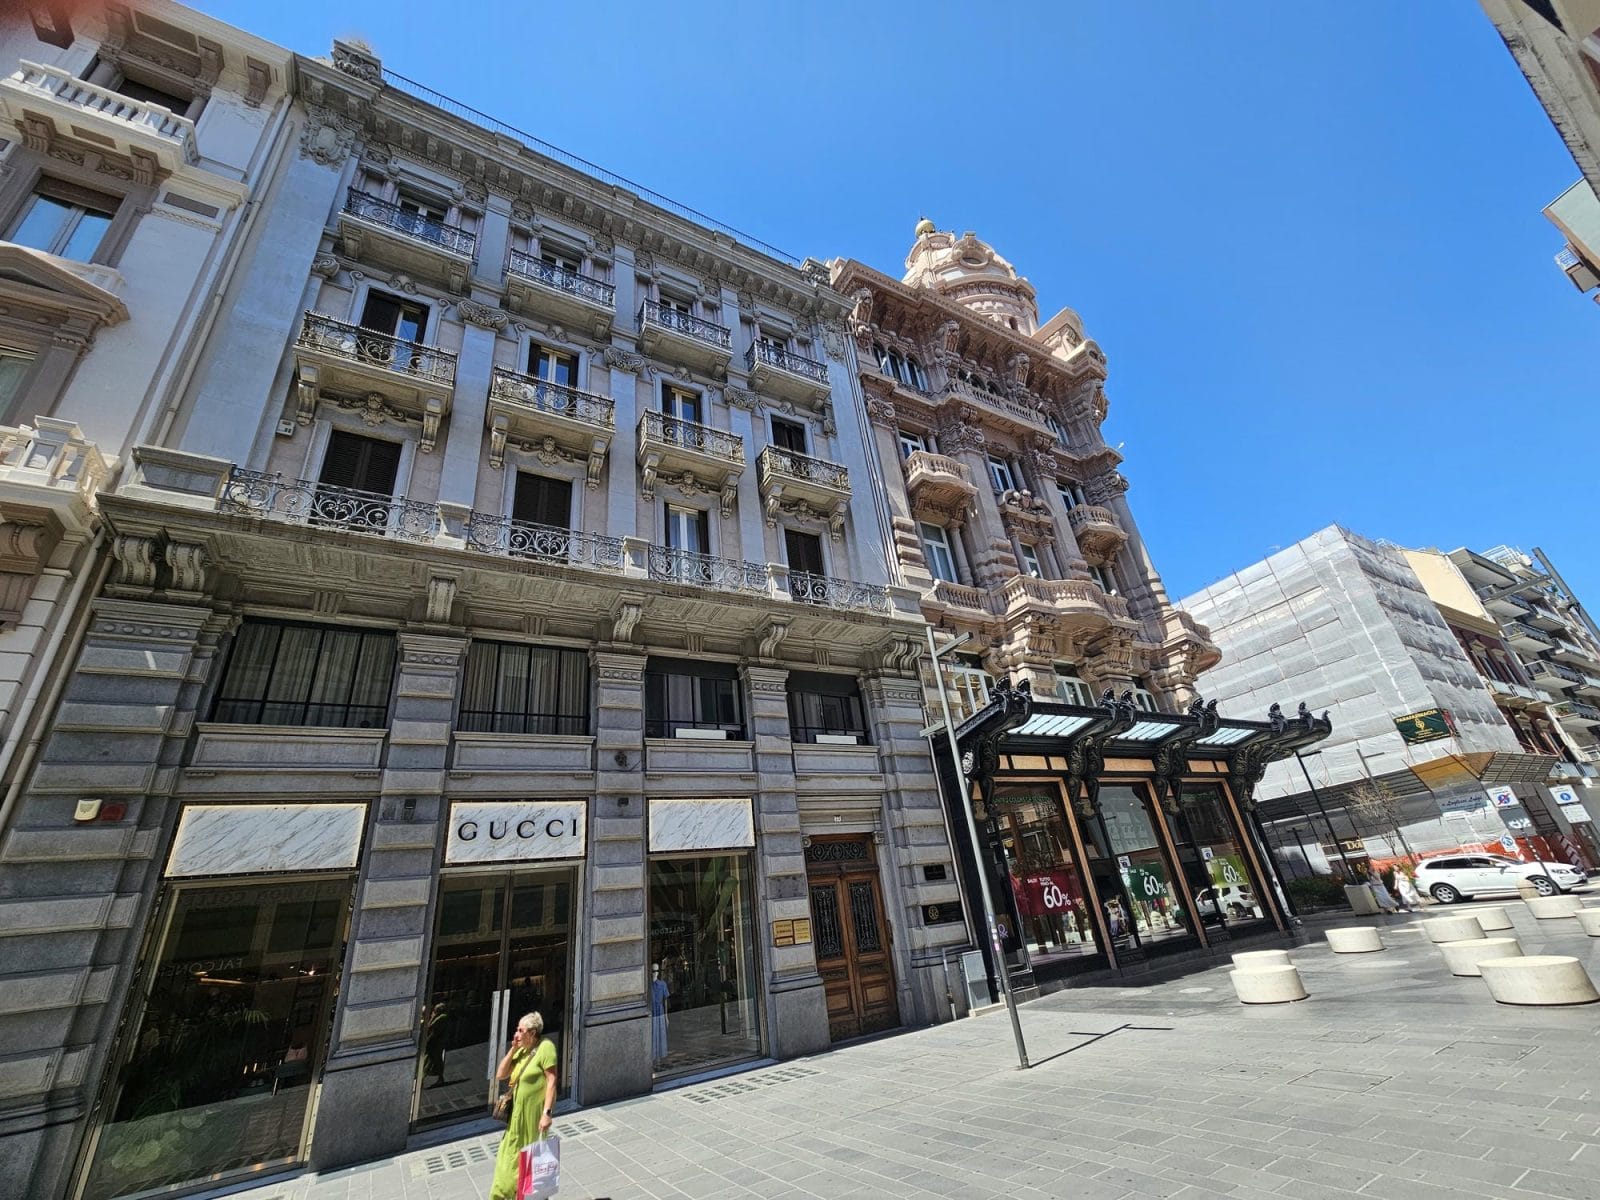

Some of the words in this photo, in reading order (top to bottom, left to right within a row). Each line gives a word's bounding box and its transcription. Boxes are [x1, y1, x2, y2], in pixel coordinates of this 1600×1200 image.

[458, 819, 577, 841] GUCCI
[1223, 865, 1243, 883] 60%
[1143, 875, 1167, 896] 60%
[1043, 885, 1072, 909] 60%
